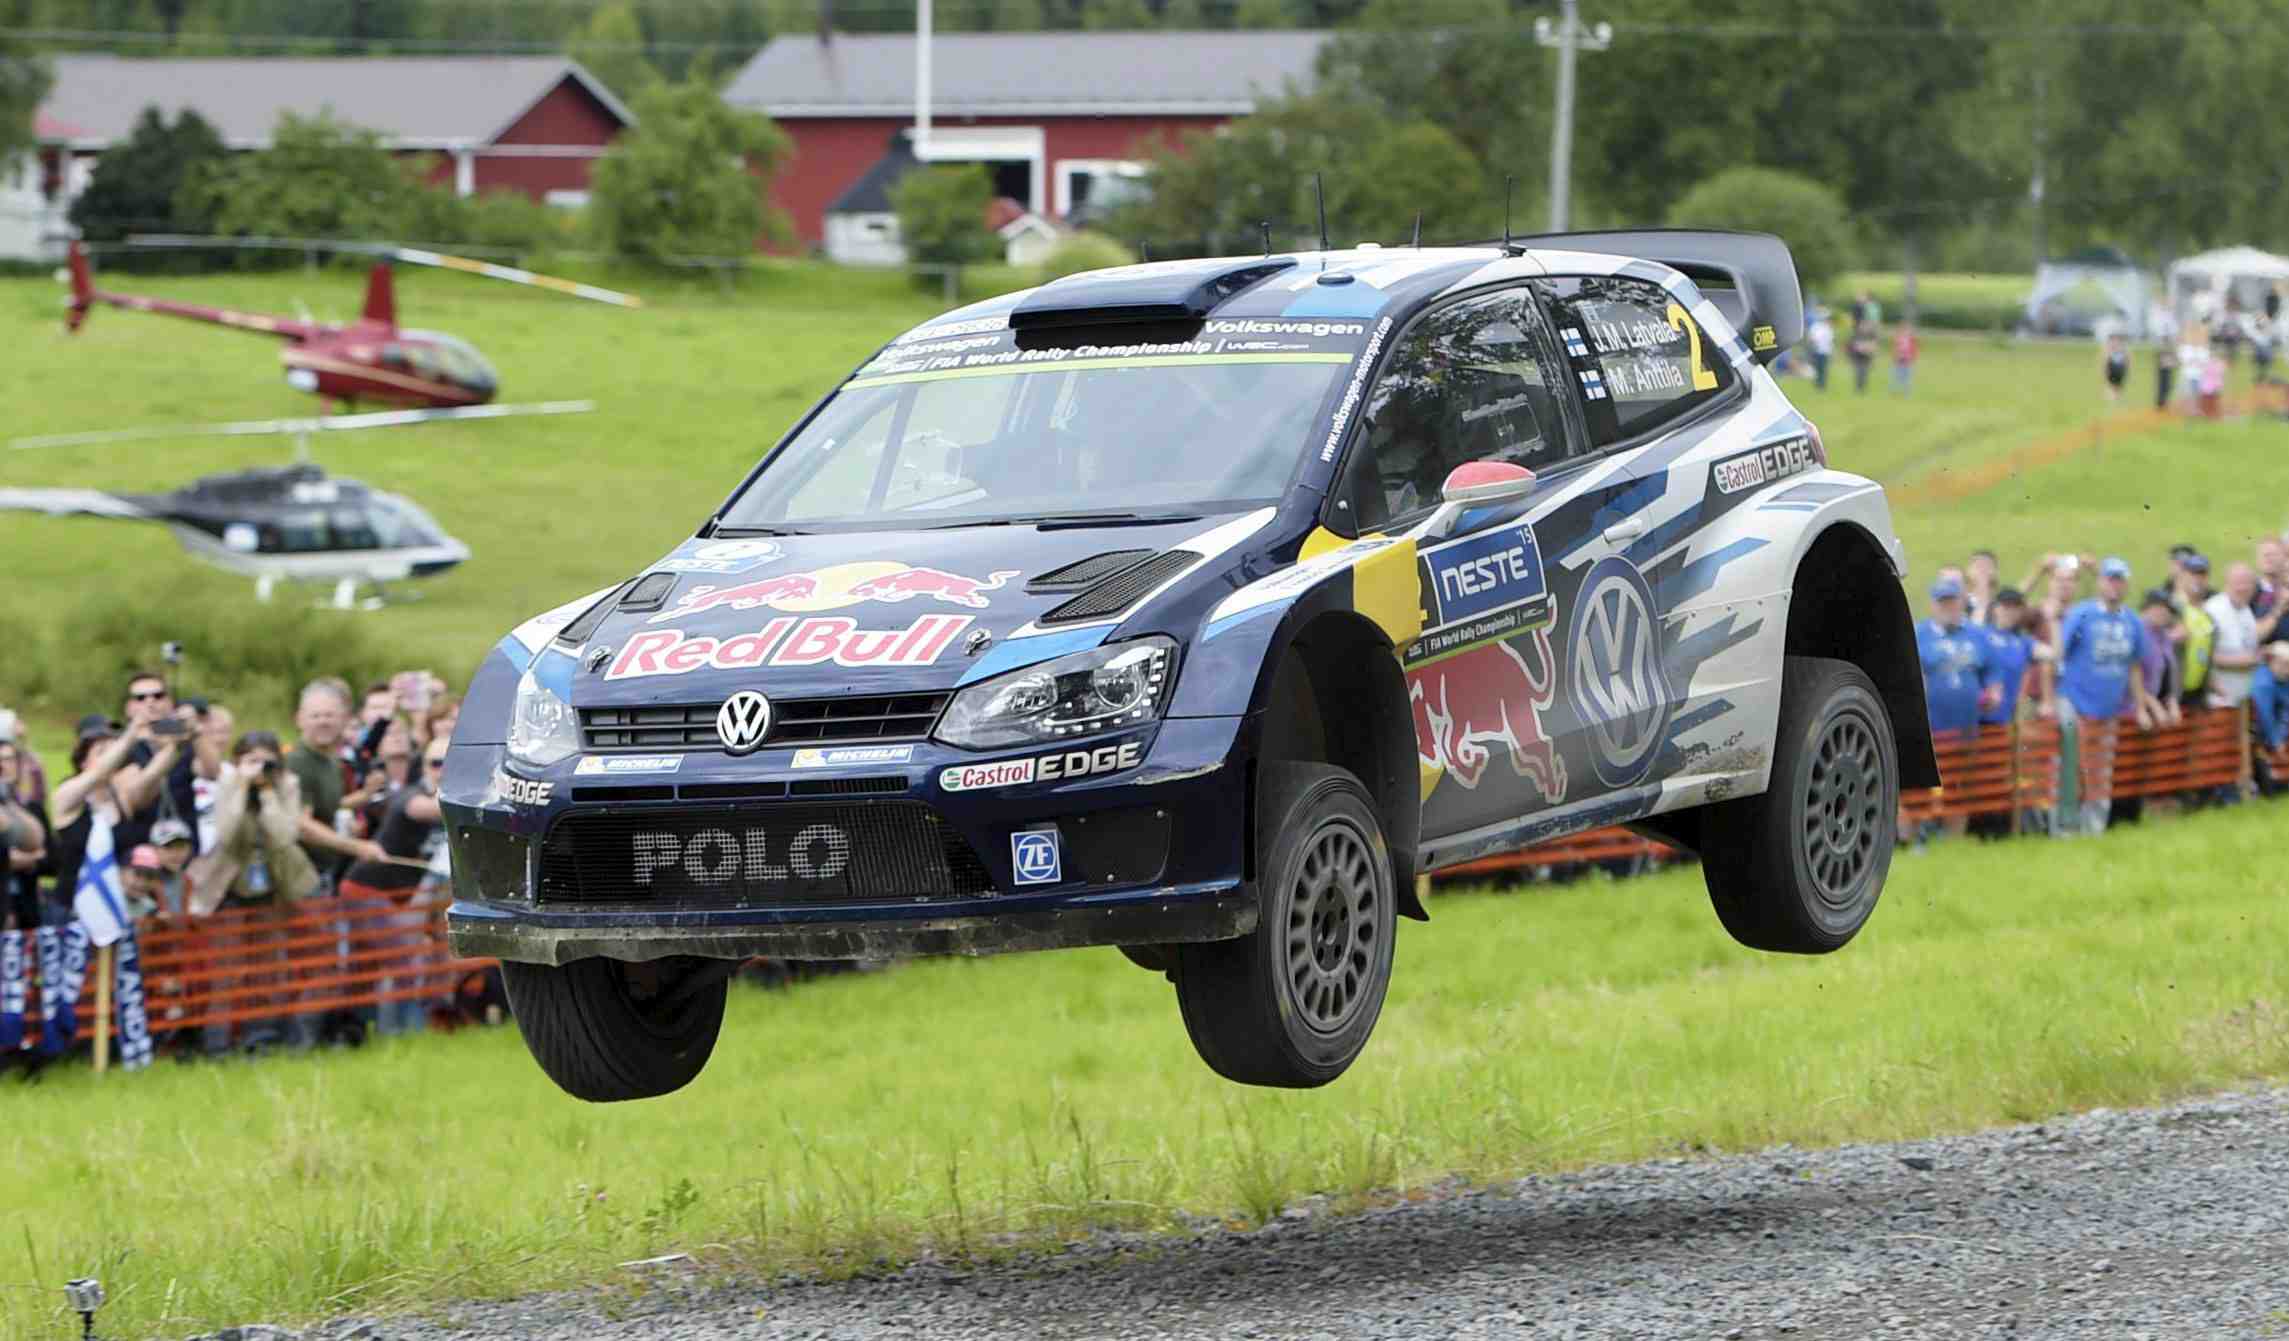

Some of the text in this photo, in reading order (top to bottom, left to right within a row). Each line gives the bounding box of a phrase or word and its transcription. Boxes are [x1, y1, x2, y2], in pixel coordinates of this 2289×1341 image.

[1205, 321, 1364, 337] Volkswagen
[1621, 316, 1677, 348] Latvala
[1667, 303, 1718, 391] 2
[965, 348, 1018, 368] World
[1022, 348, 1070, 362] Rally
[1074, 341, 1211, 357] Championship
[1608, 359, 1684, 395] M. Anttila
[1319, 316, 1393, 463] www.volkswagen-motorsport.com
[1726, 438, 1814, 489] Castrol EDGE
[1440, 546, 1529, 602] NESTE
[606, 615, 972, 678] Red Bull
[962, 742, 1145, 788] Castrol EDGE
[633, 824, 849, 888] POLO
[1019, 844, 1051, 872] ZF
